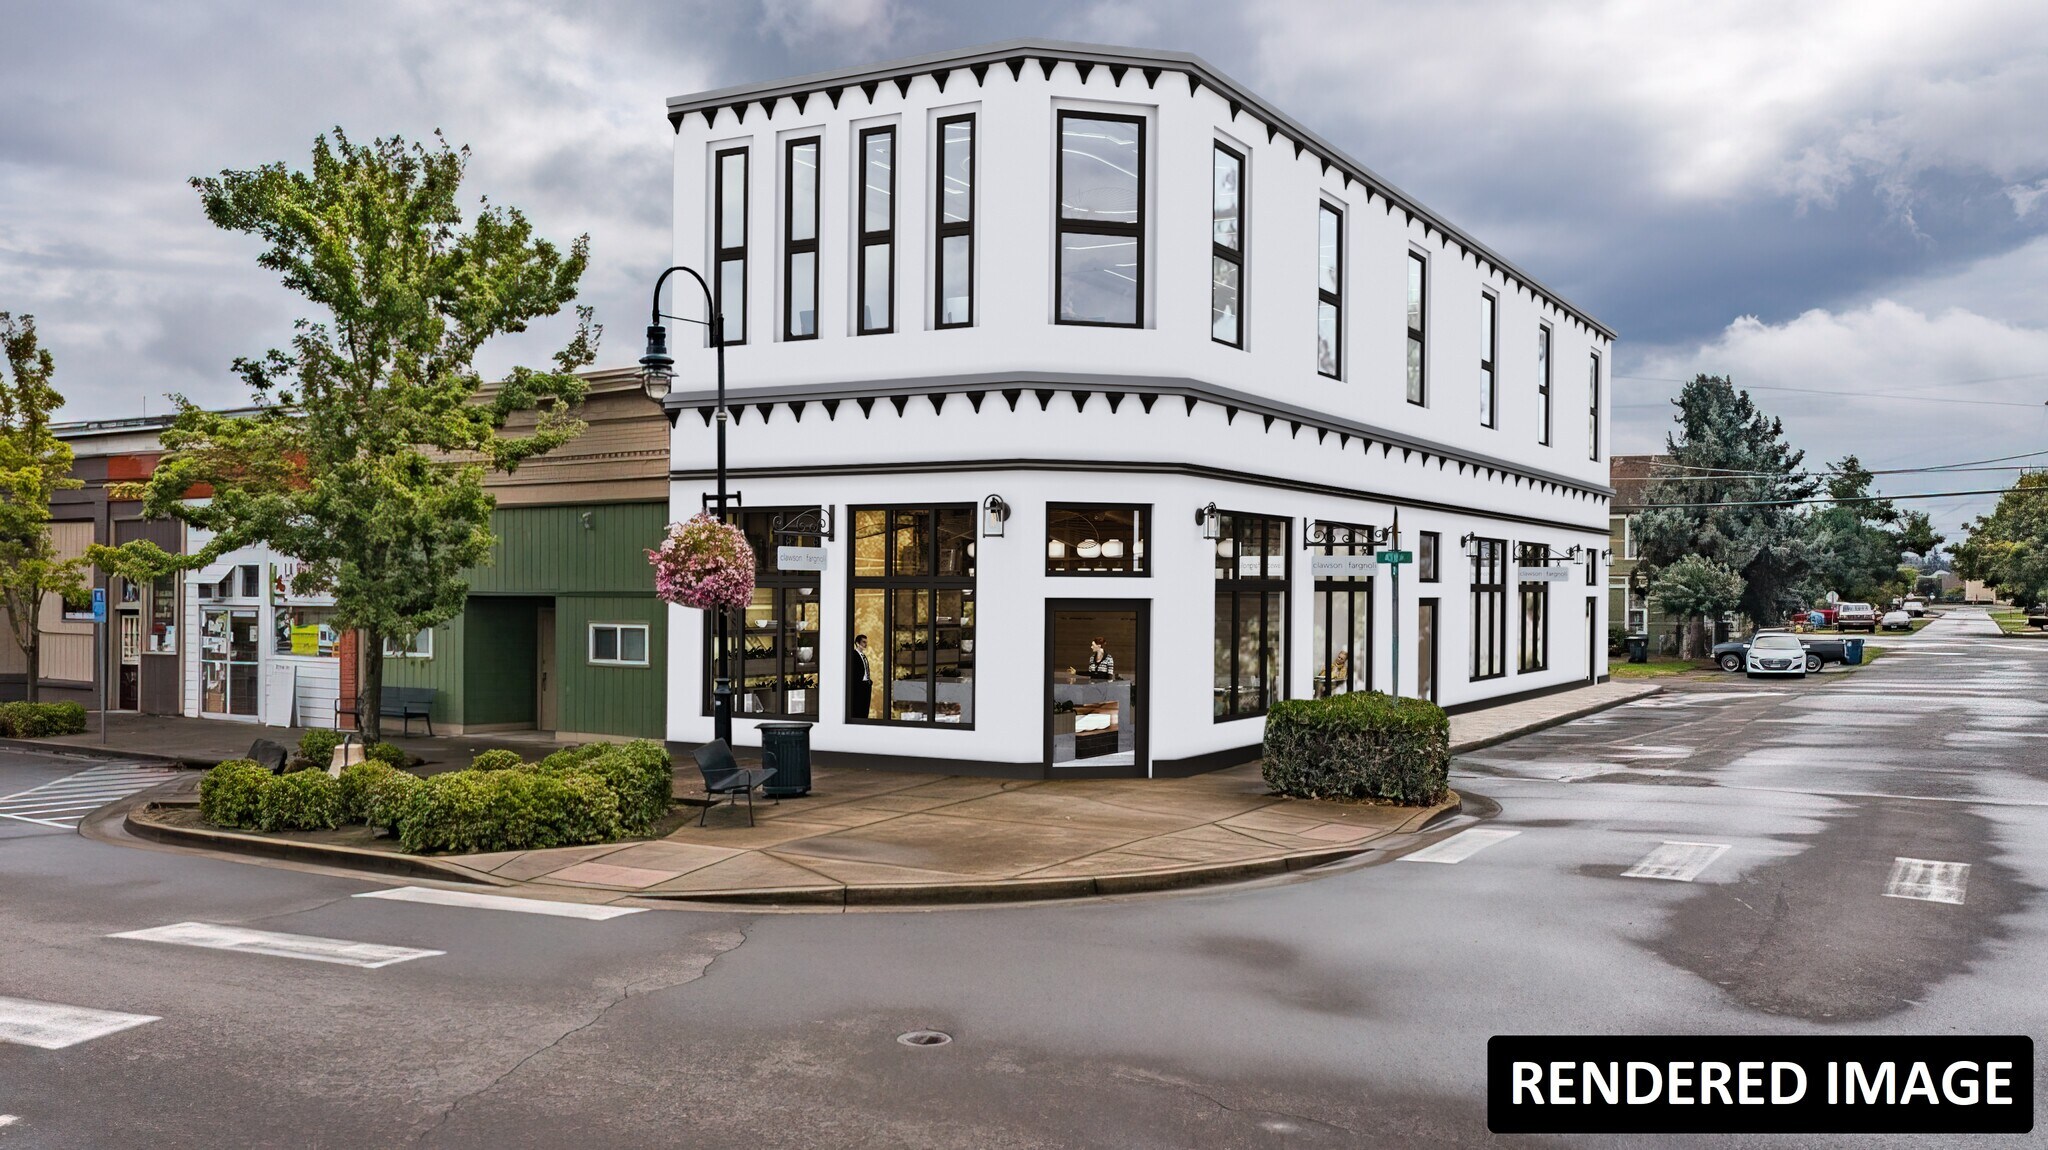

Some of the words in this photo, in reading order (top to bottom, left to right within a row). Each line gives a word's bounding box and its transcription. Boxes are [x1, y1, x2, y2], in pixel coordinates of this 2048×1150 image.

[780, 553, 803, 562] clawson
[1312, 561, 1343, 569] clawson
[1348, 561, 1377, 571] fargnoli
